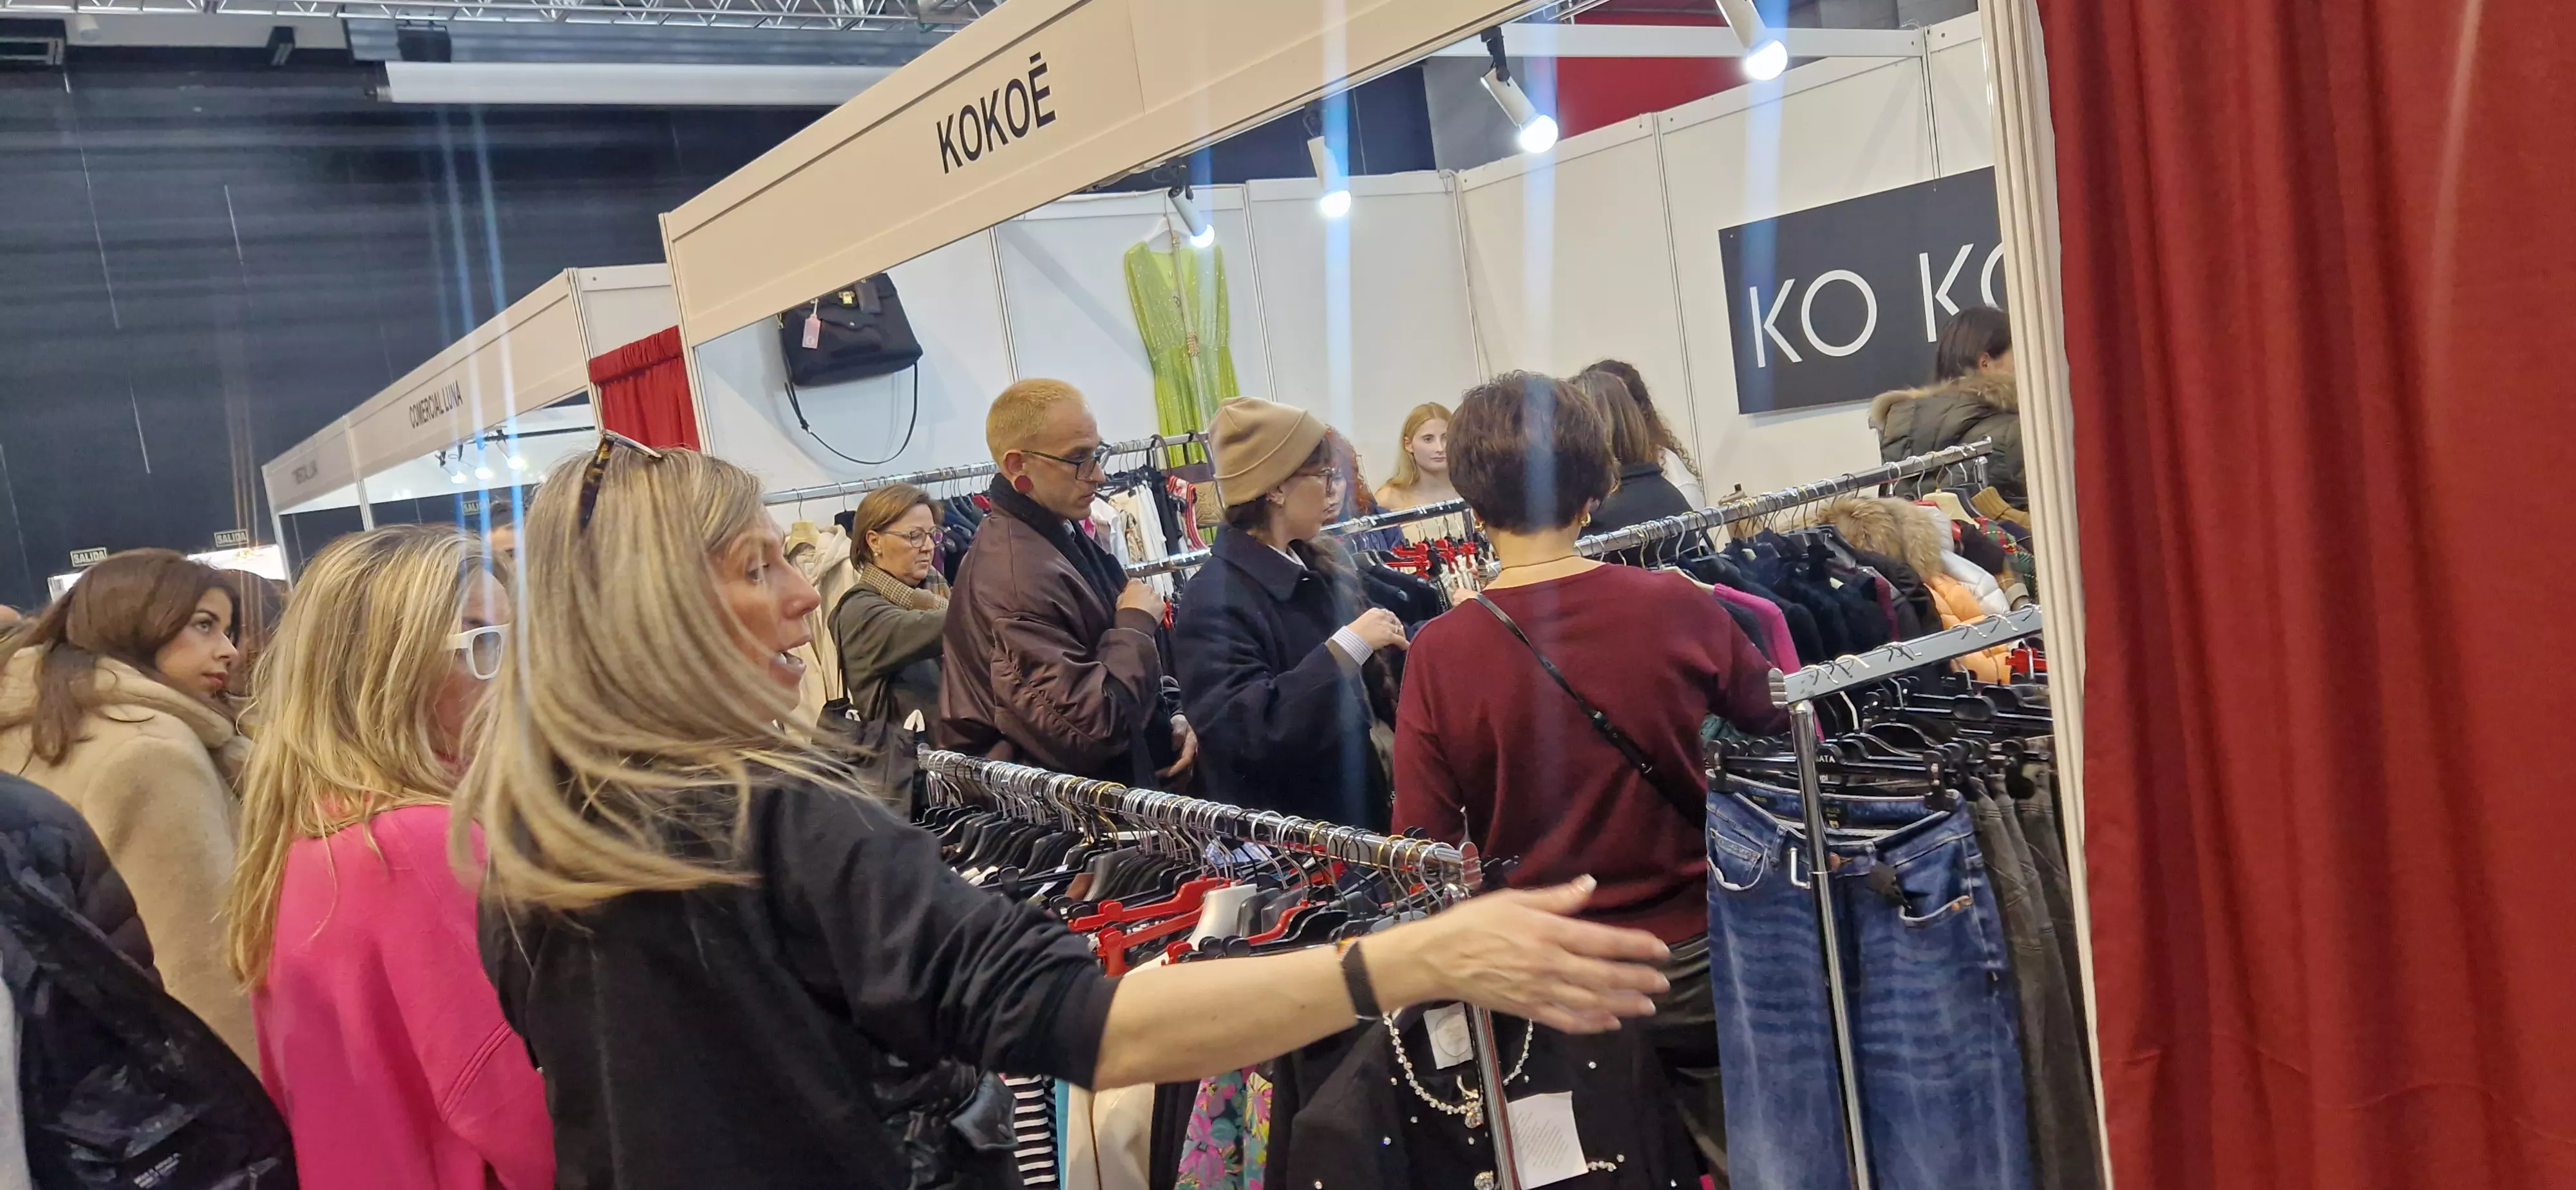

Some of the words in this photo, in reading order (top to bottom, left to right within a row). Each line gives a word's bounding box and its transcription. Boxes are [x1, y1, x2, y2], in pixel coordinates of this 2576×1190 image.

[1749, 269, 1877, 368] KO
[409, 390, 444, 430] COMERCIAL
[442, 379, 463, 412] LUNA
[216, 532, 247, 545] SALIDA
[73, 551, 106, 564] SALIDA
